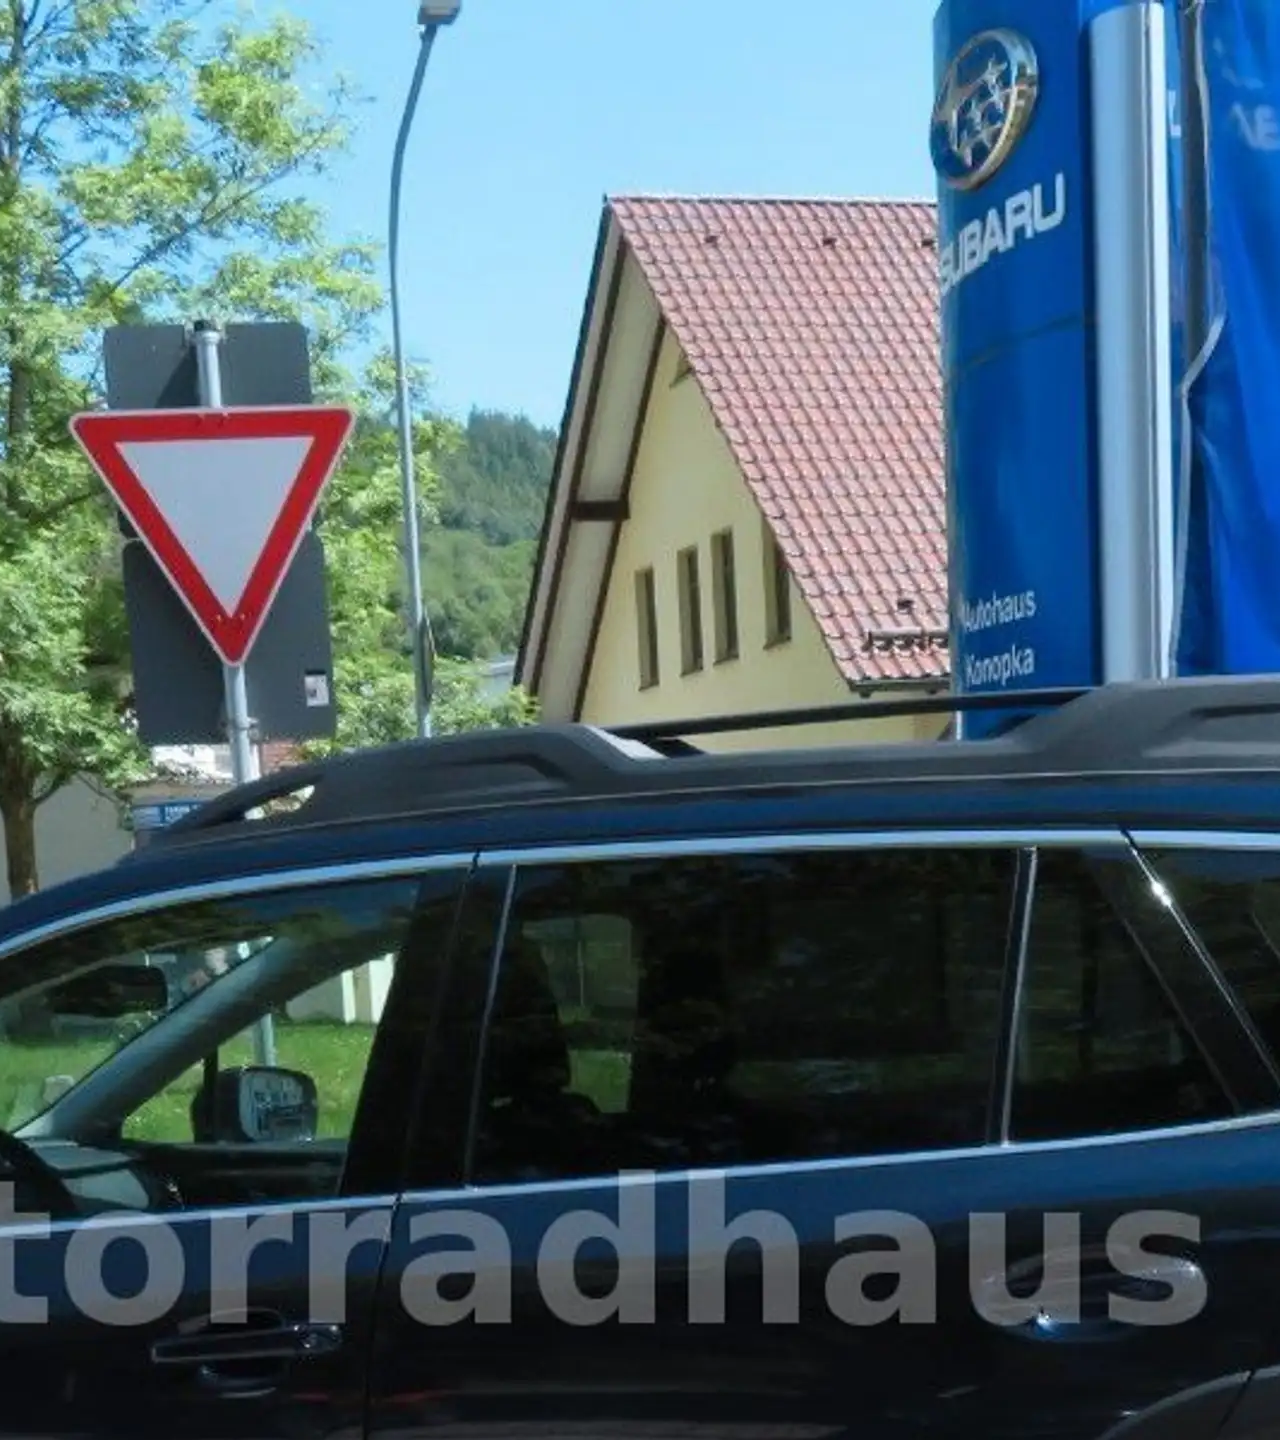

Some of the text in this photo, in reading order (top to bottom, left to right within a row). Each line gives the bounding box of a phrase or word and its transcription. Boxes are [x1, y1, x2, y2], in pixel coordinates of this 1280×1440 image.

[939, 171, 1066, 298] SUBARU
[960, 589, 1036, 632] Autohaus
[965, 644, 1035, 687] Konopka
